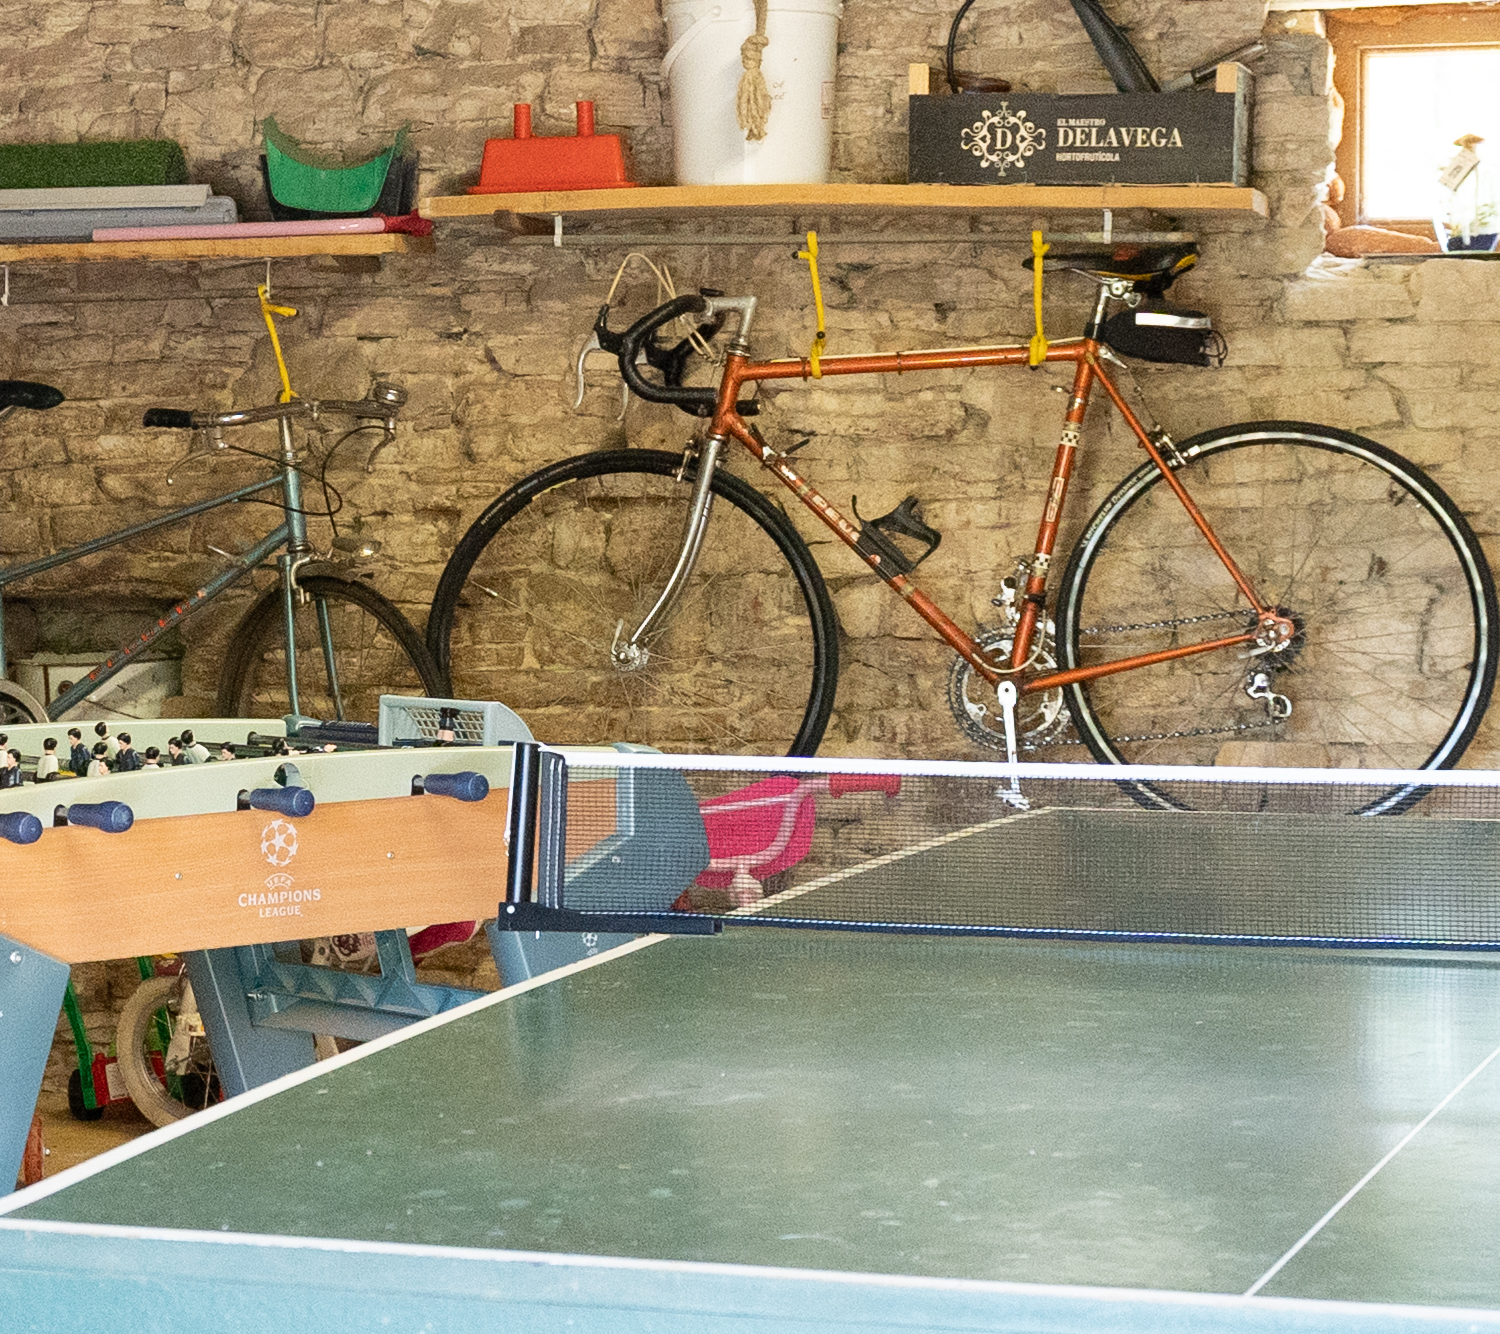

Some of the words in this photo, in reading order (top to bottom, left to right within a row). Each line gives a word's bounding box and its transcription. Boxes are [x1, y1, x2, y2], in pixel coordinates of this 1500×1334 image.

[1056, 127, 1184, 148] DELAVEGA
[237, 888, 322, 908] CHAMPIONS
[259, 905, 302, 919] LEAGUE
